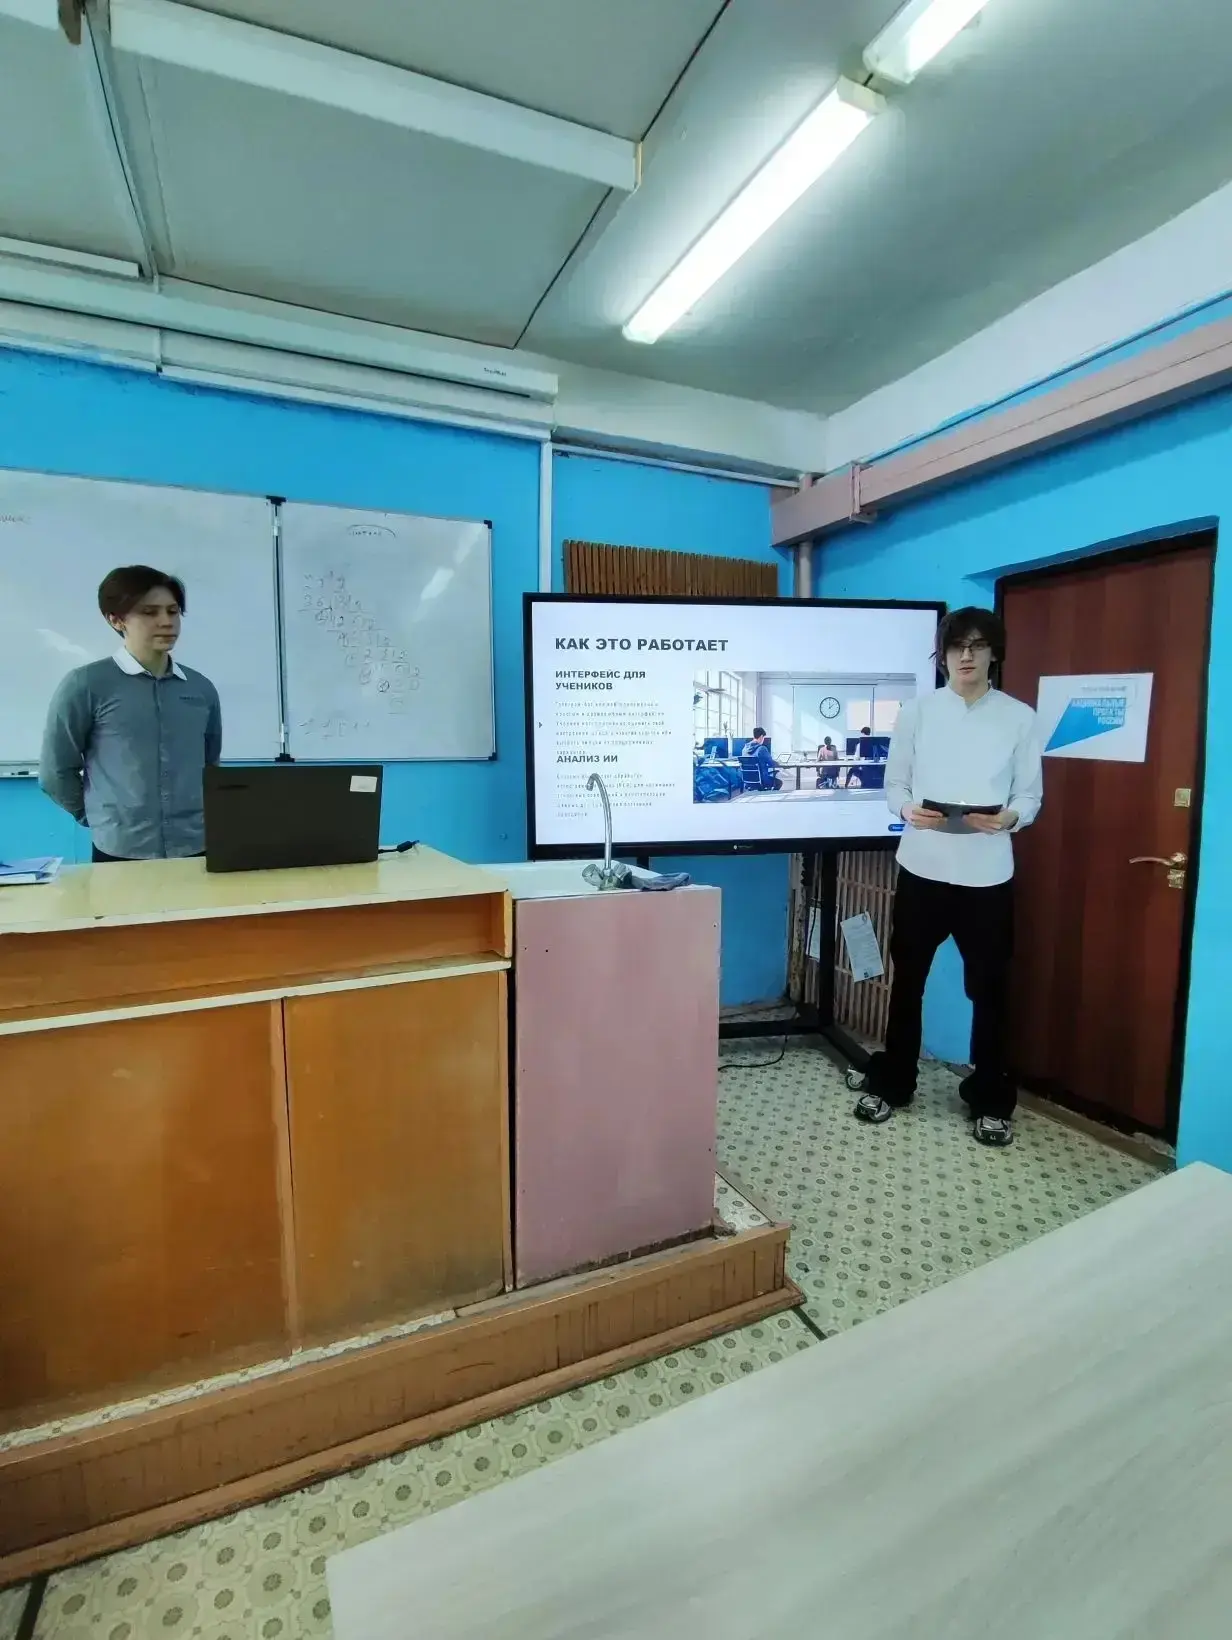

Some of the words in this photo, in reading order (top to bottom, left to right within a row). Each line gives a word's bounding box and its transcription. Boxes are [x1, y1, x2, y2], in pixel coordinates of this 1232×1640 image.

[555, 638, 589, 650] КАК
[596, 638, 632, 650] ЭТО
[637, 639, 729, 651] РАБОТАЕТ
[555, 669, 621, 679] ИНТЕРФЕЙС
[623, 671, 646, 679] ДЛЯ
[555, 682, 613, 690] УЧЕНИКОВ
[556, 755, 600, 763] АНАЛИЗ
[603, 755, 618, 763] ИИ
